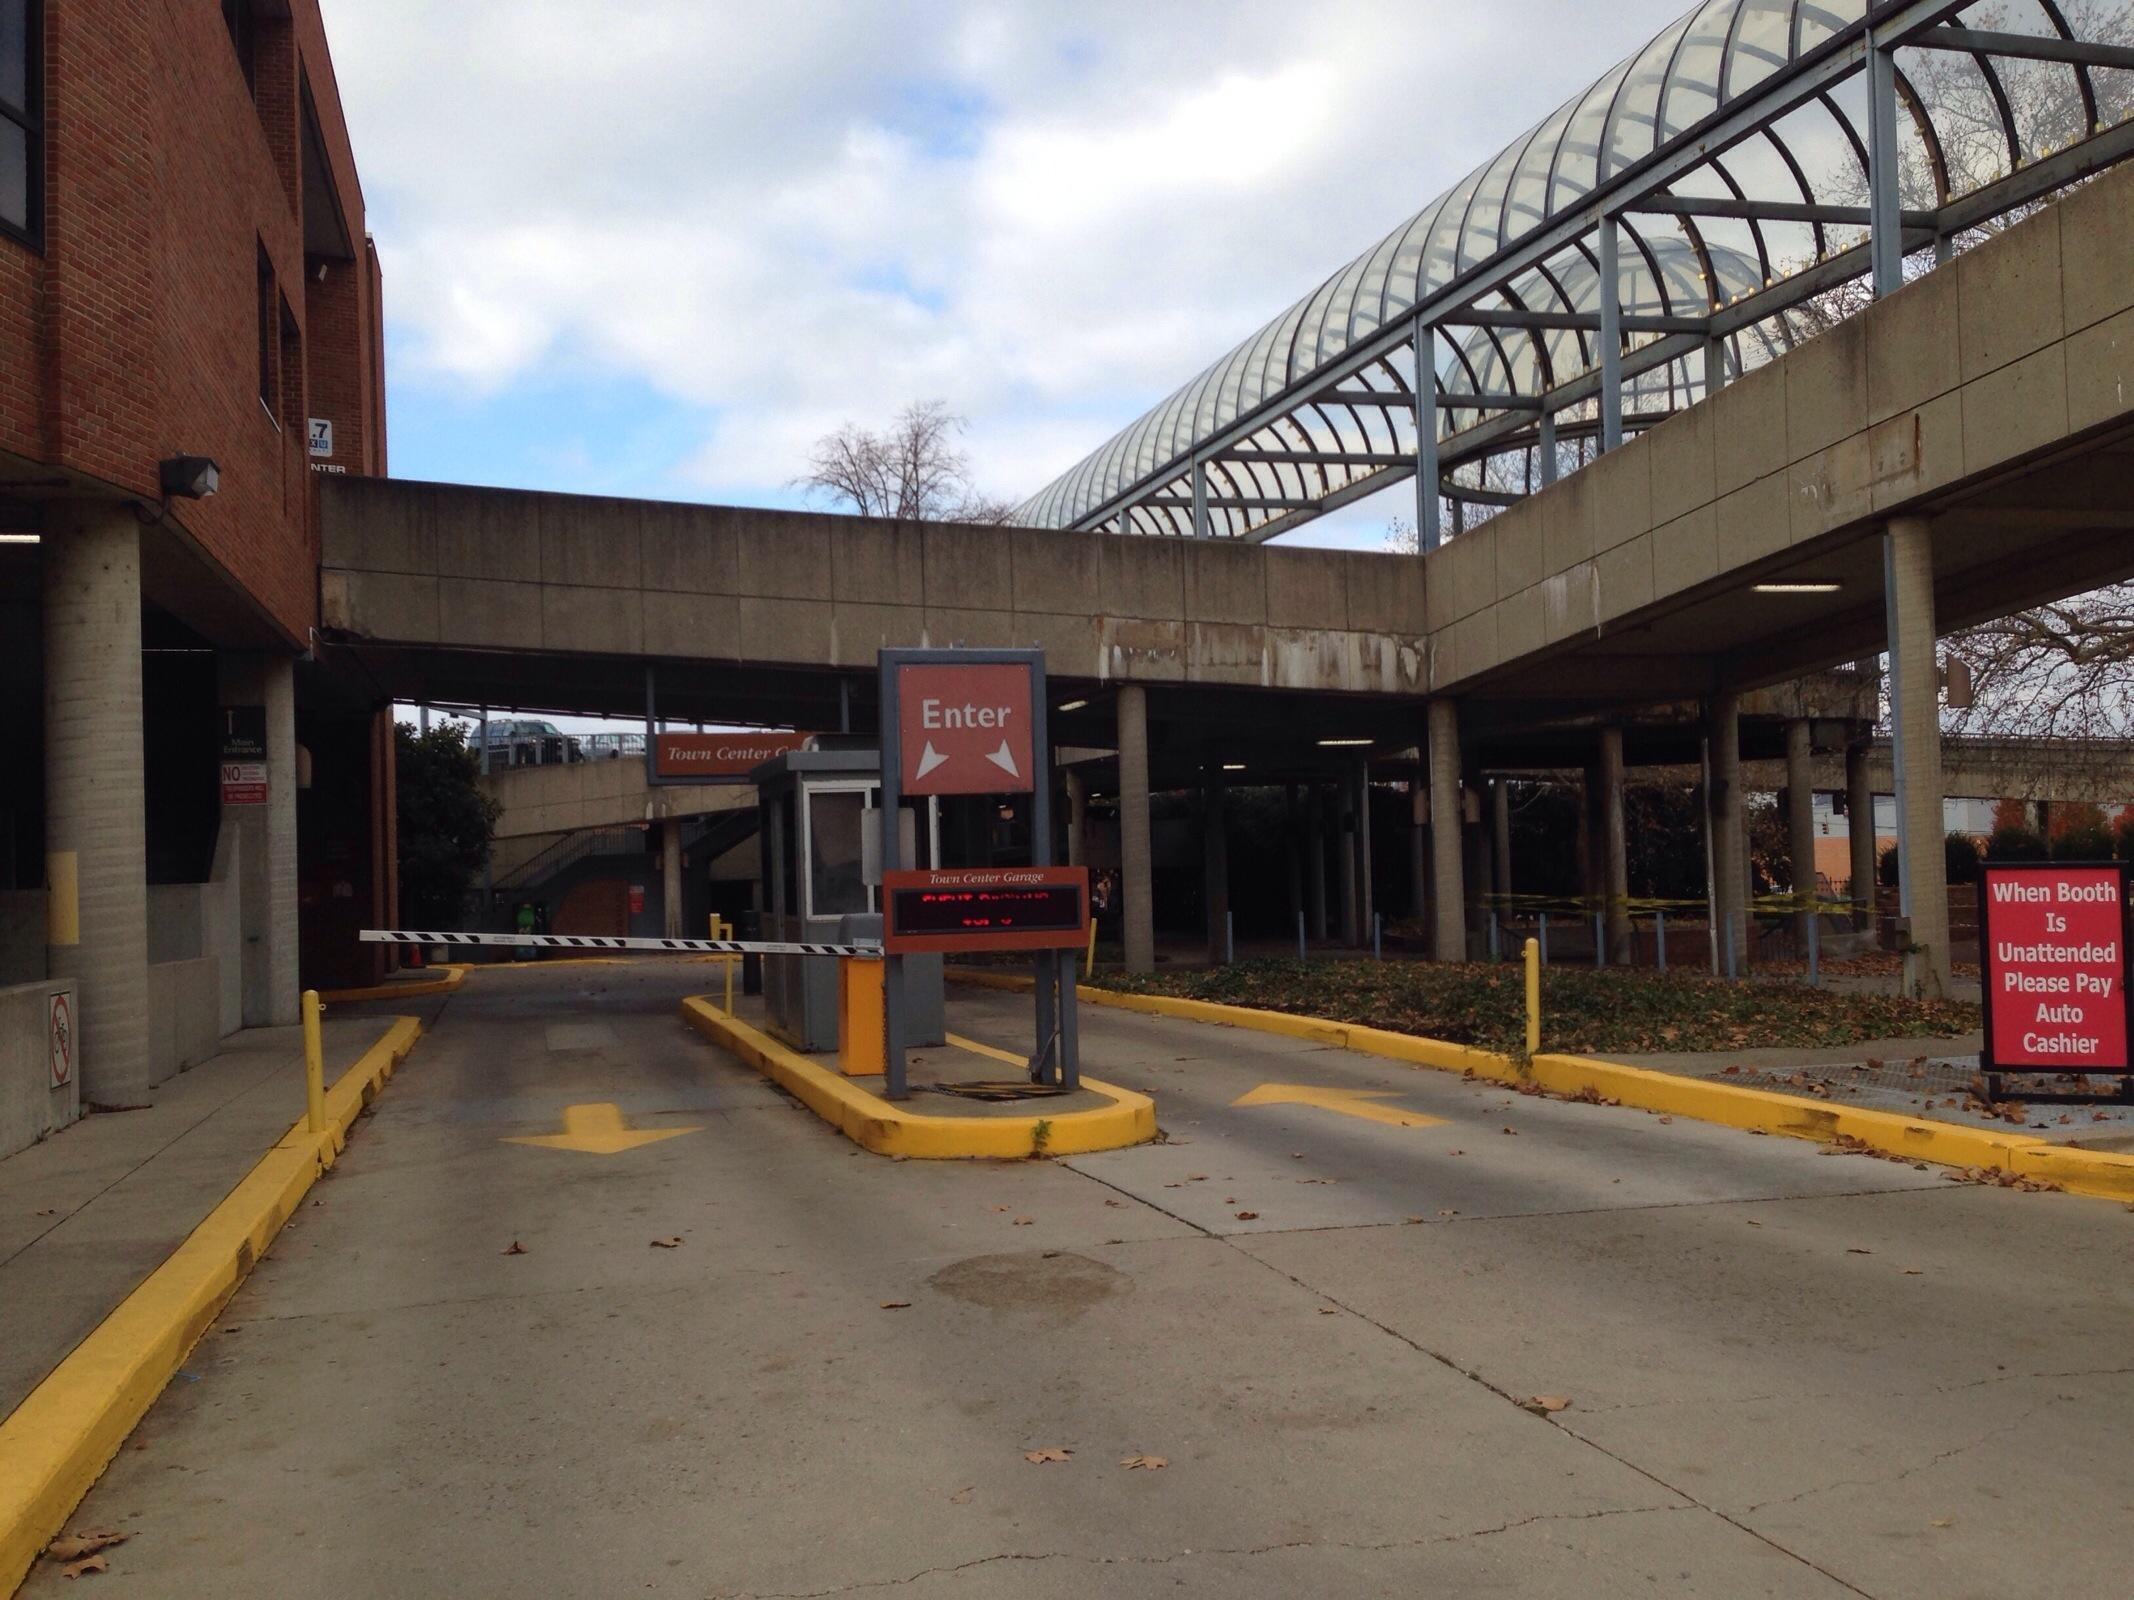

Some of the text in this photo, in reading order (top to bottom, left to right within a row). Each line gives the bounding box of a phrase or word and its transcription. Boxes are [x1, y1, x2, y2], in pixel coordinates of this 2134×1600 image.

[922, 698, 1012, 729] Enter
[668, 747, 711, 761] Town
[716, 746, 771, 760] Center
[223, 766, 240, 781] NO
[929, 872, 1044, 884] Town Center Garage
[1993, 882, 2117, 903] When Booth
[2046, 912, 2067, 932] Is
[1998, 942, 2117, 963] Unattended
[2004, 973, 2113, 998] Please Pay
[2036, 1003, 2083, 1023] Auto
[2023, 1032, 2099, 1053] Cashier
